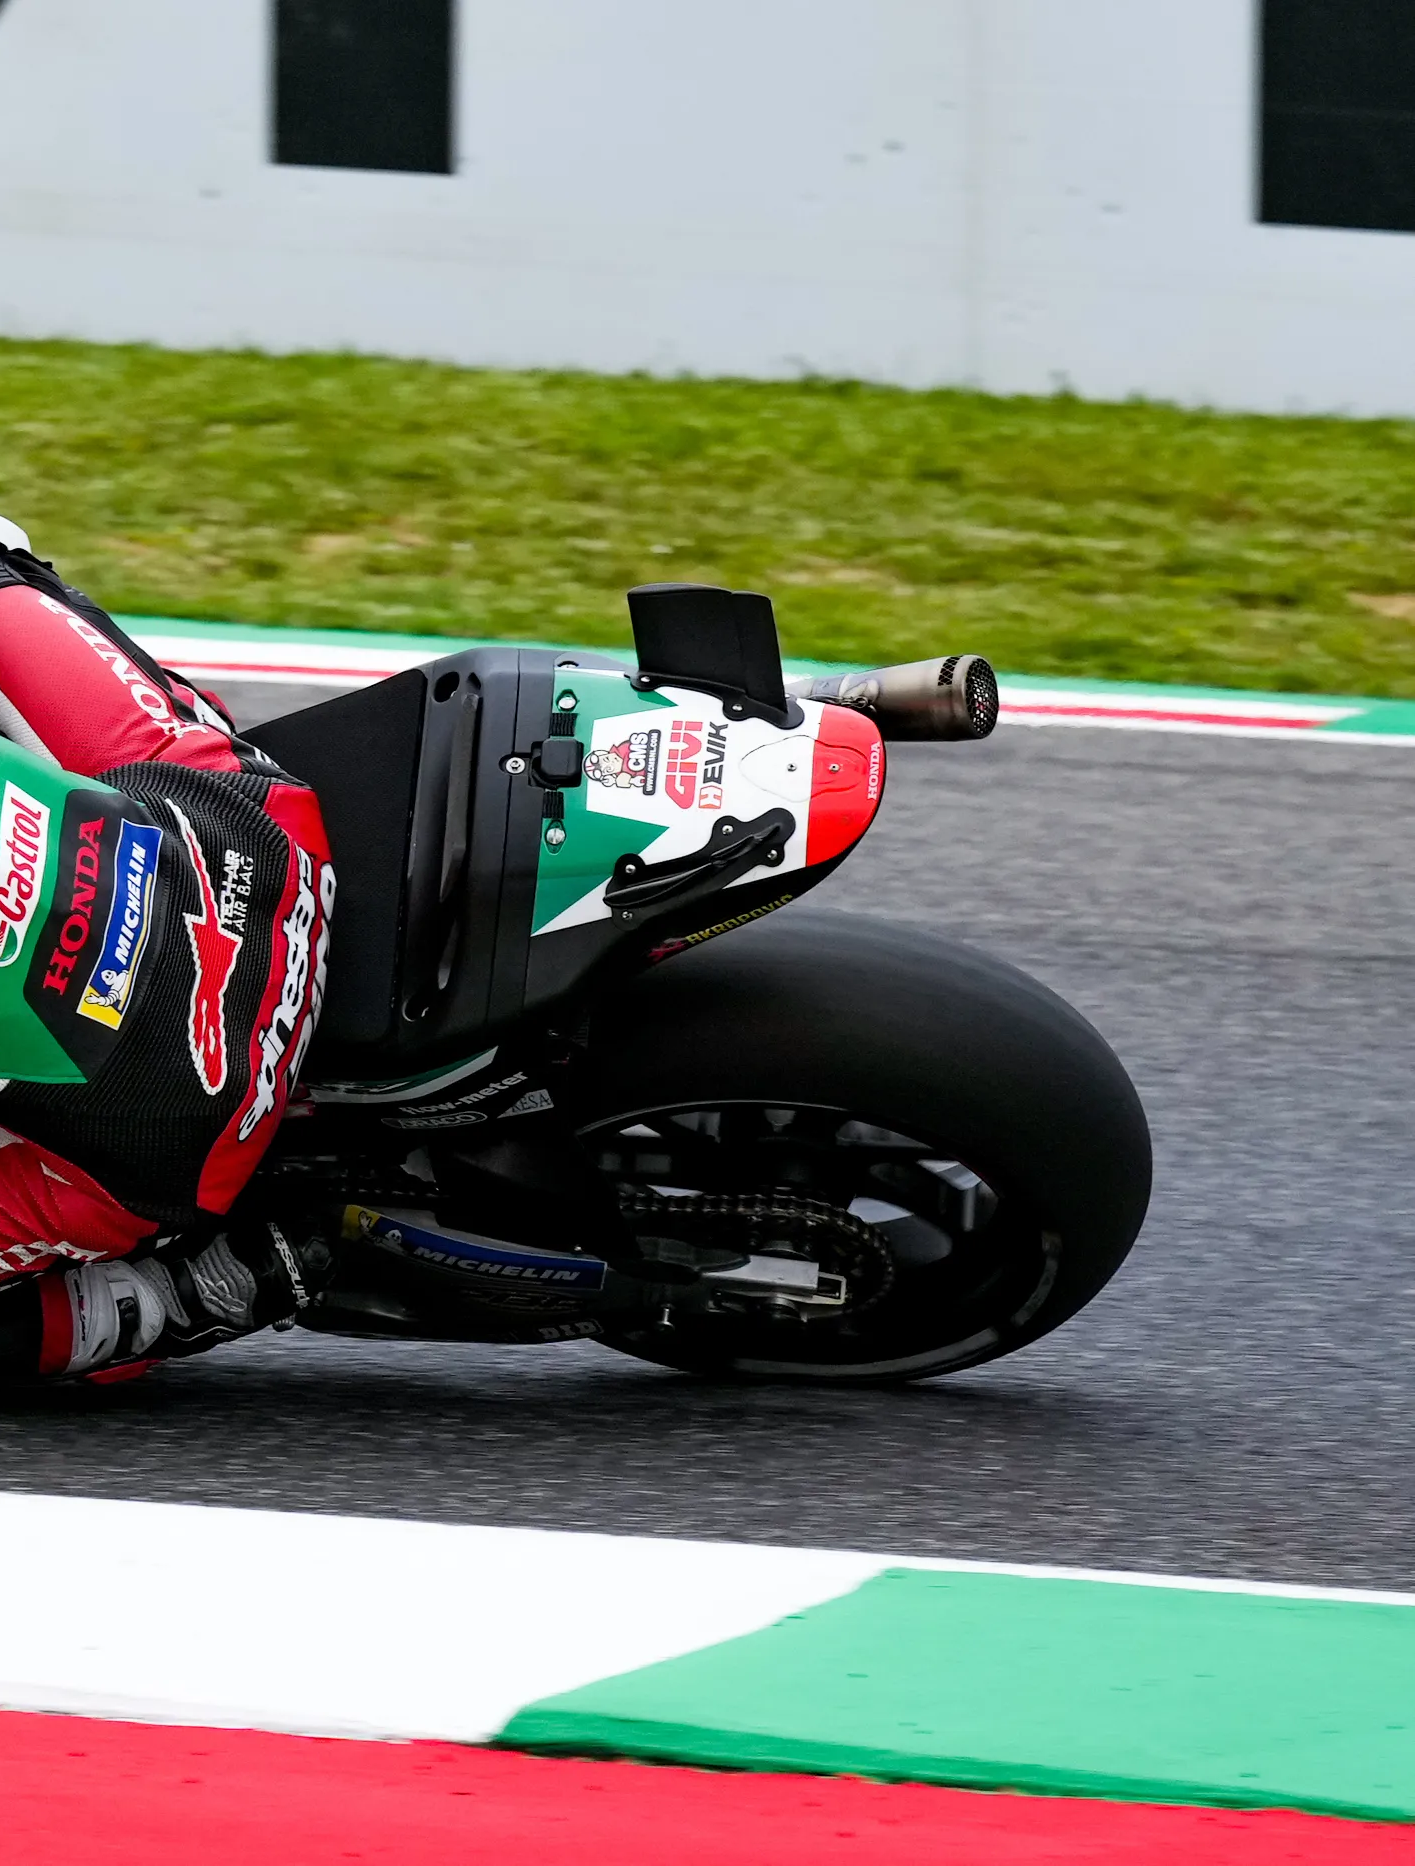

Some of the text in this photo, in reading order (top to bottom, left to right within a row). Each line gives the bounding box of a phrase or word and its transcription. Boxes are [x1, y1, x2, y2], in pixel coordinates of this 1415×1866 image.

[628, 732, 649, 772] CMS
[645, 733, 660, 792] WWW.CMSNL.COM
[665, 720, 703, 810] GIVI
[698, 721, 729, 810] HEVIK
[867, 741, 882, 800] HONDA
[43, 817, 106, 996] HONDA
[115, 841, 147, 966] MICHELIN
[235, 855, 254, 932] AIR BAG
[238, 841, 316, 1142] alpinestars
[398, 1071, 529, 1115] flow-meter
[414, 1246, 581, 1282] MICHELIN
